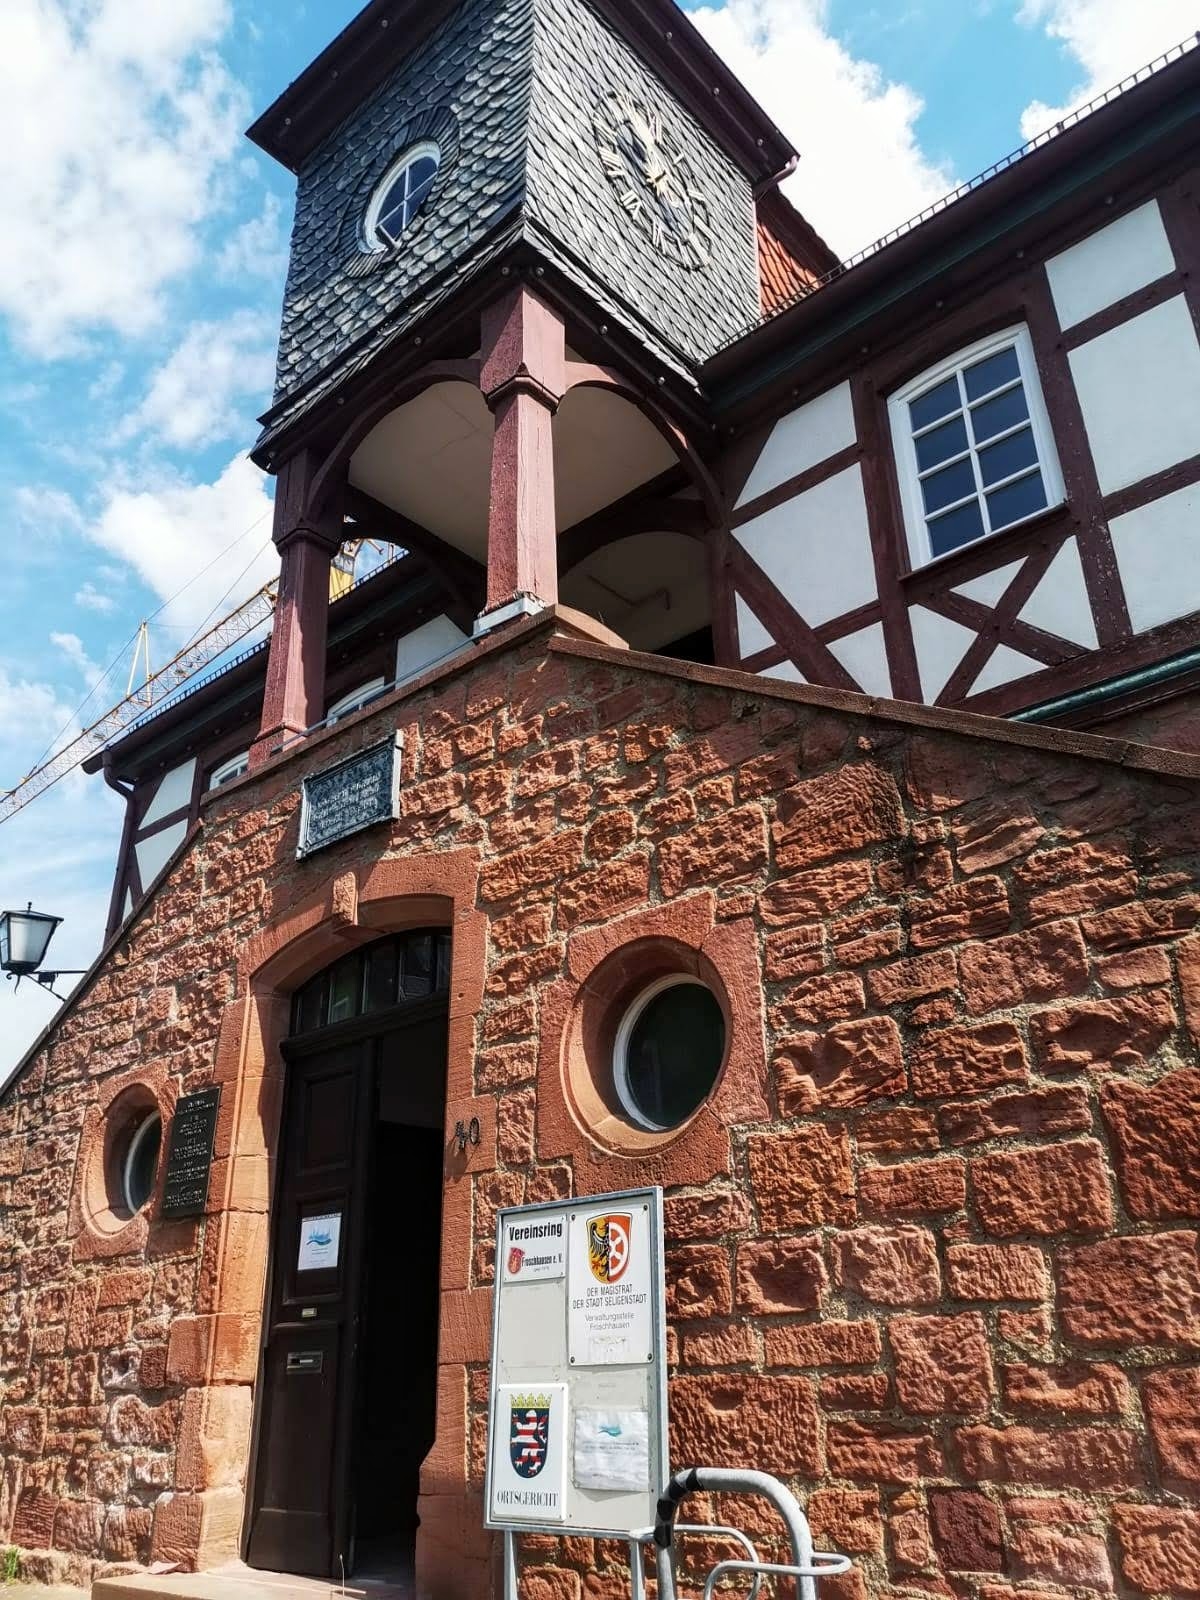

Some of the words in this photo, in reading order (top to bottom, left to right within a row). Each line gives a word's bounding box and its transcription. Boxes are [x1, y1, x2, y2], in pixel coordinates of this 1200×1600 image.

[509, 1222, 562, 1241] Vereinsring
[521, 1255, 552, 1267] Froschhausen
[586, 1287, 598, 1298] DER
[600, 1284, 633, 1296] MAGISTRAT
[572, 1299, 584, 1310] DER
[586, 1297, 603, 1309] STADT
[604, 1293, 647, 1306] SELIGENSTADT
[585, 1311, 635, 1322] Verwaltungsstelle
[496, 1490, 559, 1507] ORTSGERICHT
